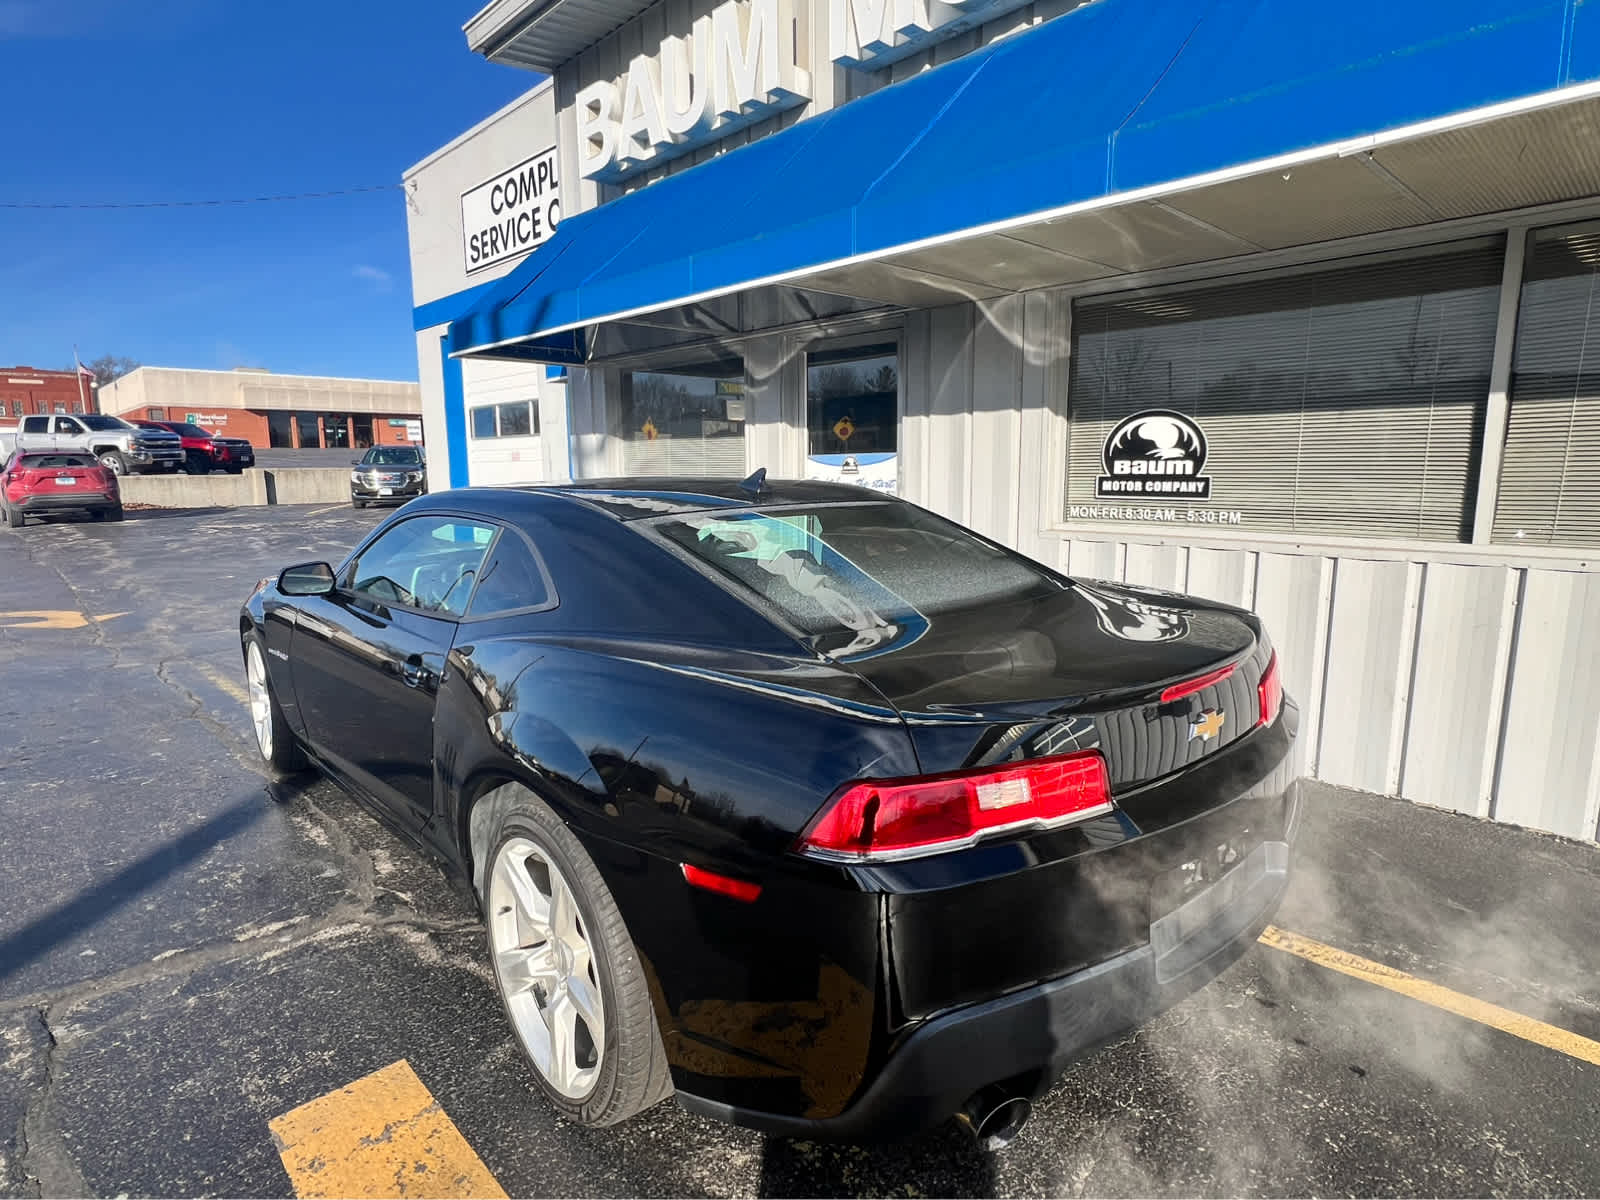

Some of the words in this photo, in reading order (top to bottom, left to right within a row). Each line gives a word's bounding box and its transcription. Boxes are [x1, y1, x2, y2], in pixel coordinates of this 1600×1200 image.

[576, 0, 785, 178] BAUM
[491, 157, 558, 215] COMPL
[470, 206, 541, 263] SERVICE
[1102, 480, 1142, 491] MOTOR
[1145, 481, 1205, 493] COMPANY
[1125, 508, 1151, 520] 8:30
[1153, 508, 1176, 521] AM
[1186, 510, 1215, 522] 5:30
[1218, 511, 1241, 524] PM
